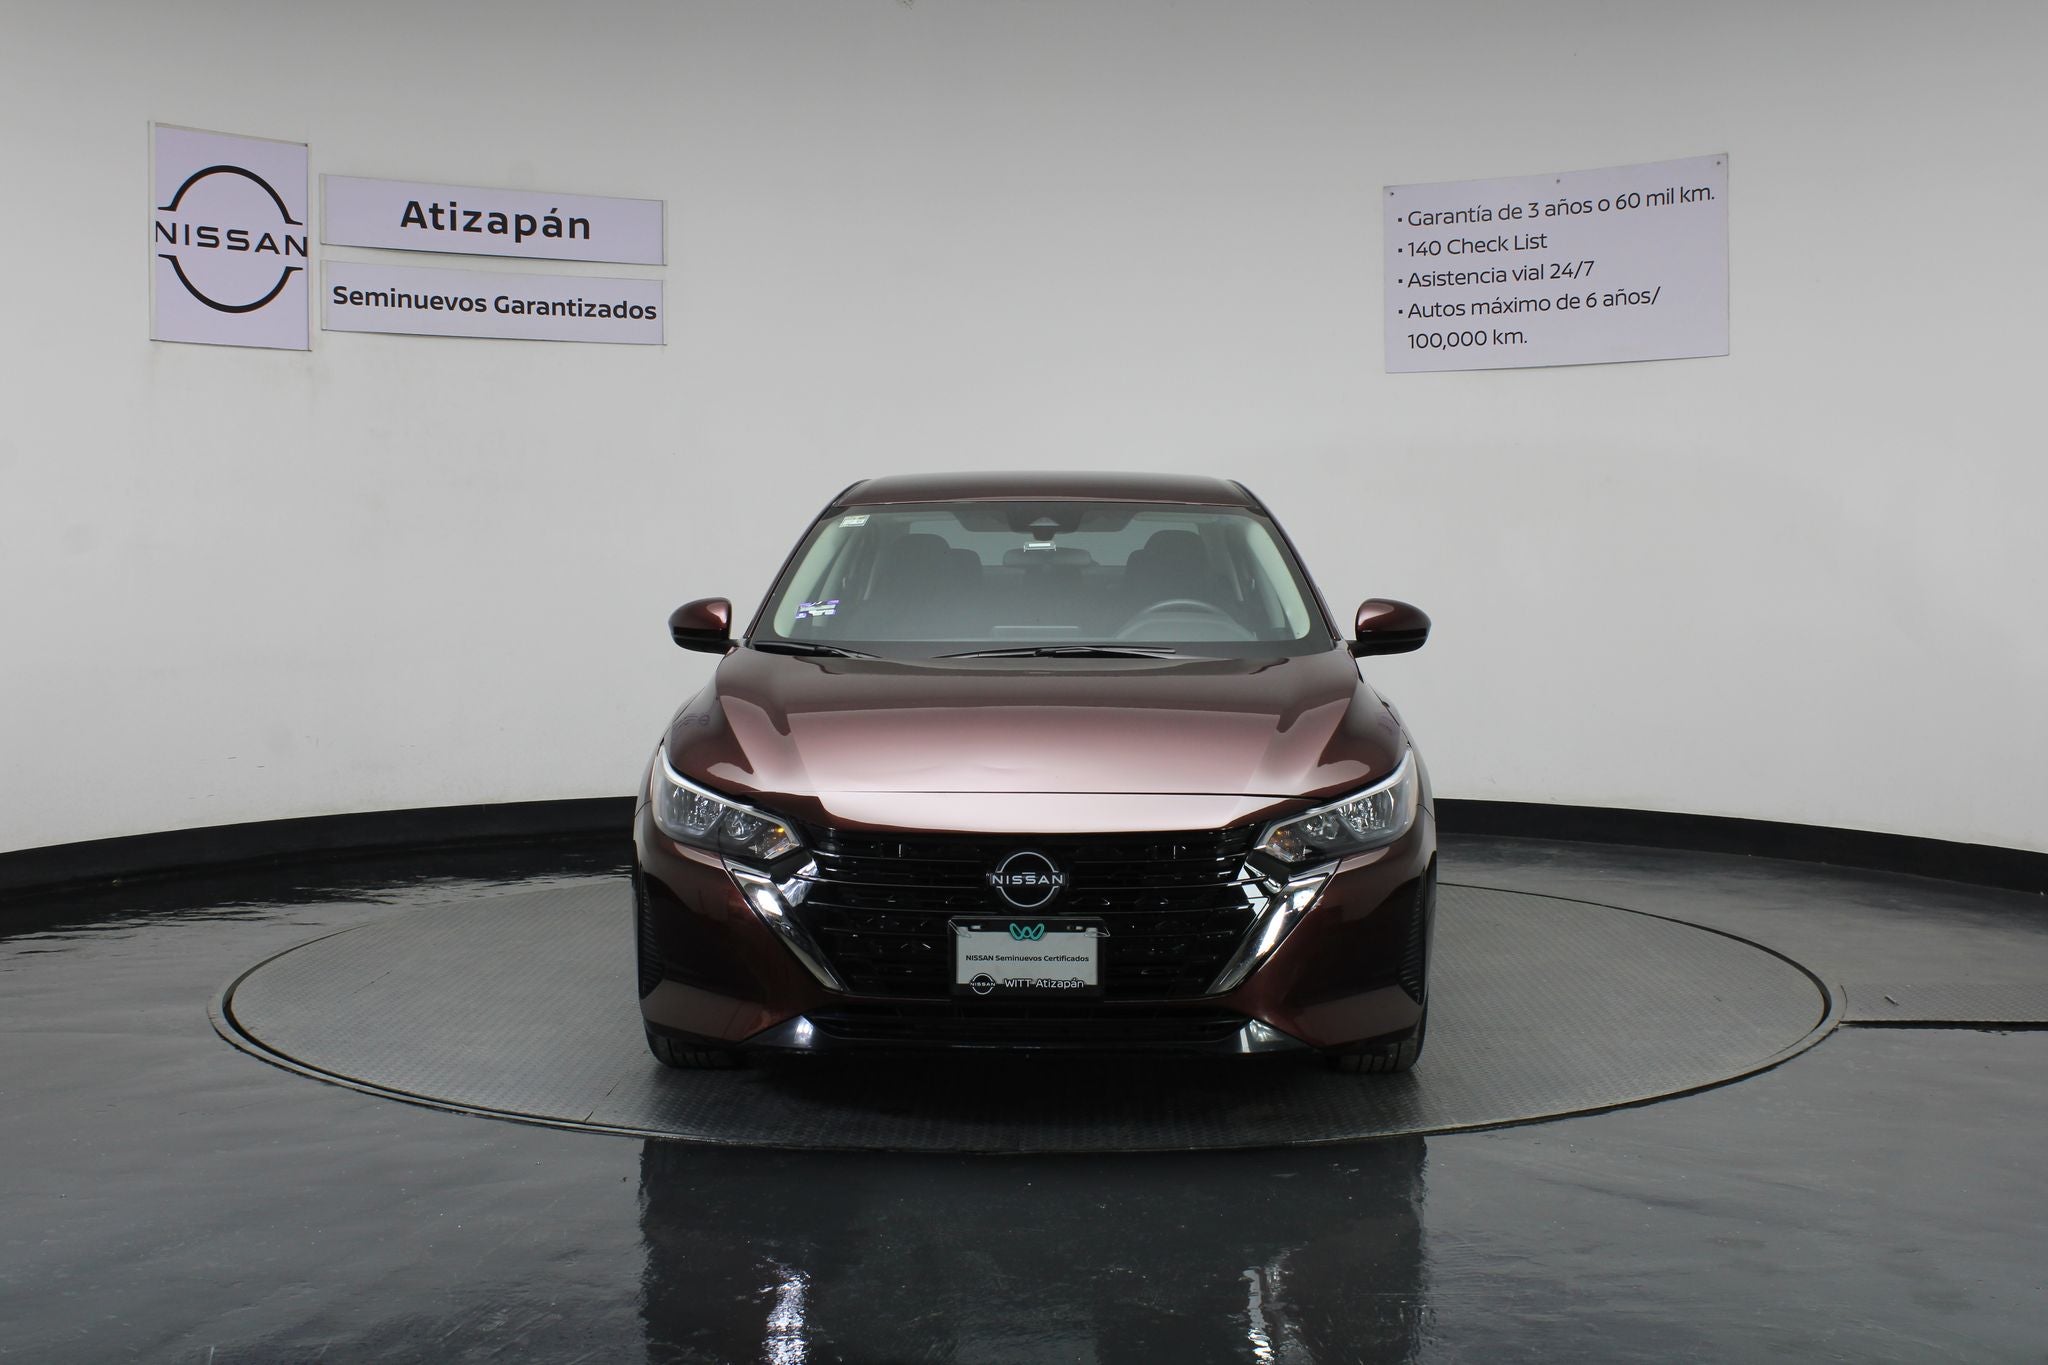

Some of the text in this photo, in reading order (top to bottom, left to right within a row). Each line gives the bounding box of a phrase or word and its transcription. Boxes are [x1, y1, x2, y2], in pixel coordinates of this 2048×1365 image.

[1408, 186, 1715, 226] Garantía de 3 años o 60 mil km.
[400, 201, 591, 243] Atizapán
[155, 221, 308, 257] NISSAN
[1408, 233, 1548, 257] 140 Check List
[1408, 261, 1595, 288] Asistencia vial 24/7
[333, 285, 657, 320] Seminuevos Garantizados
[1408, 287, 1661, 318] Autos máximo de 6 años/
[1408, 329, 1527, 350] 100,000 km.
[992, 874, 1063, 884] NISSAN
[1004, 978, 1084, 989] WITT Atizapán
